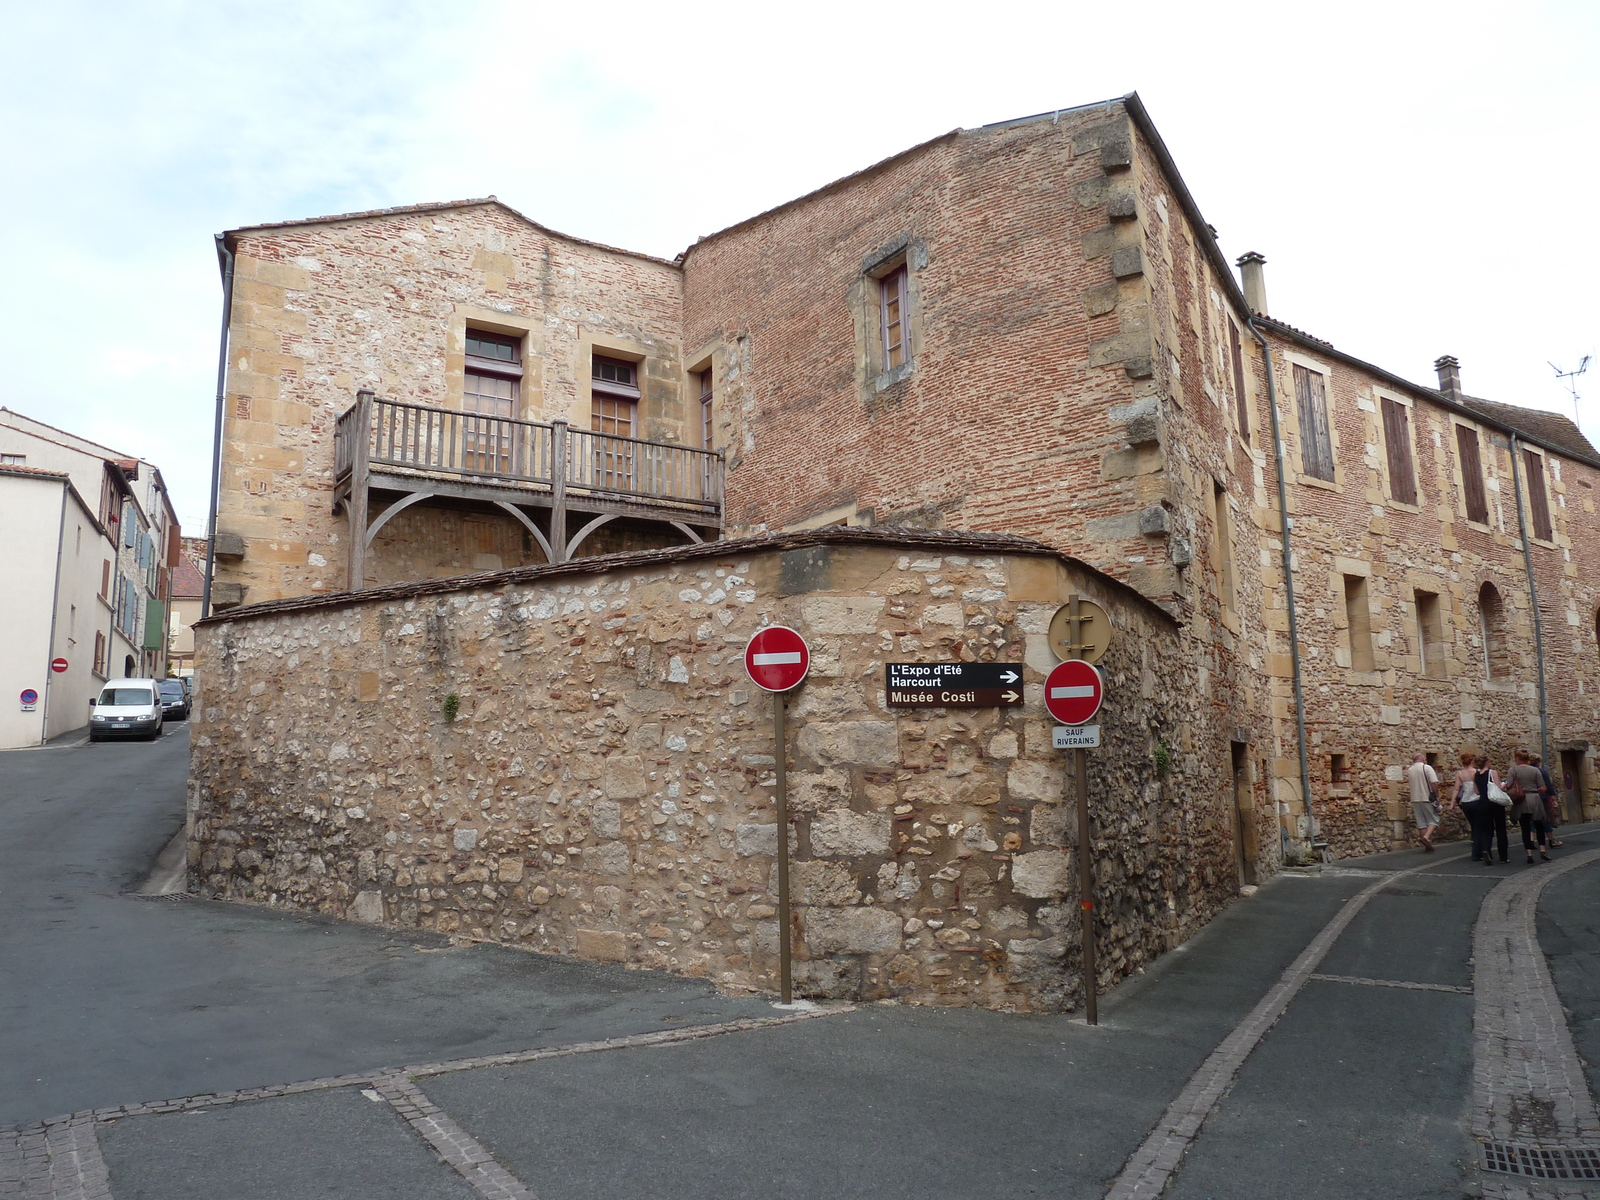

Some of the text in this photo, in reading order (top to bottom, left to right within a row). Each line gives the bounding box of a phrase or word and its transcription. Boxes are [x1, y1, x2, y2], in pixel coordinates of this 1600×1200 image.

[891, 665, 962, 677] L'Expo d'Eté
[891, 677, 942, 687] Harcourt
[891, 691, 975, 702] Musée Costi
[1065, 728, 1084, 736] SAUF
[1057, 737, 1095, 745] RIVERAINS
